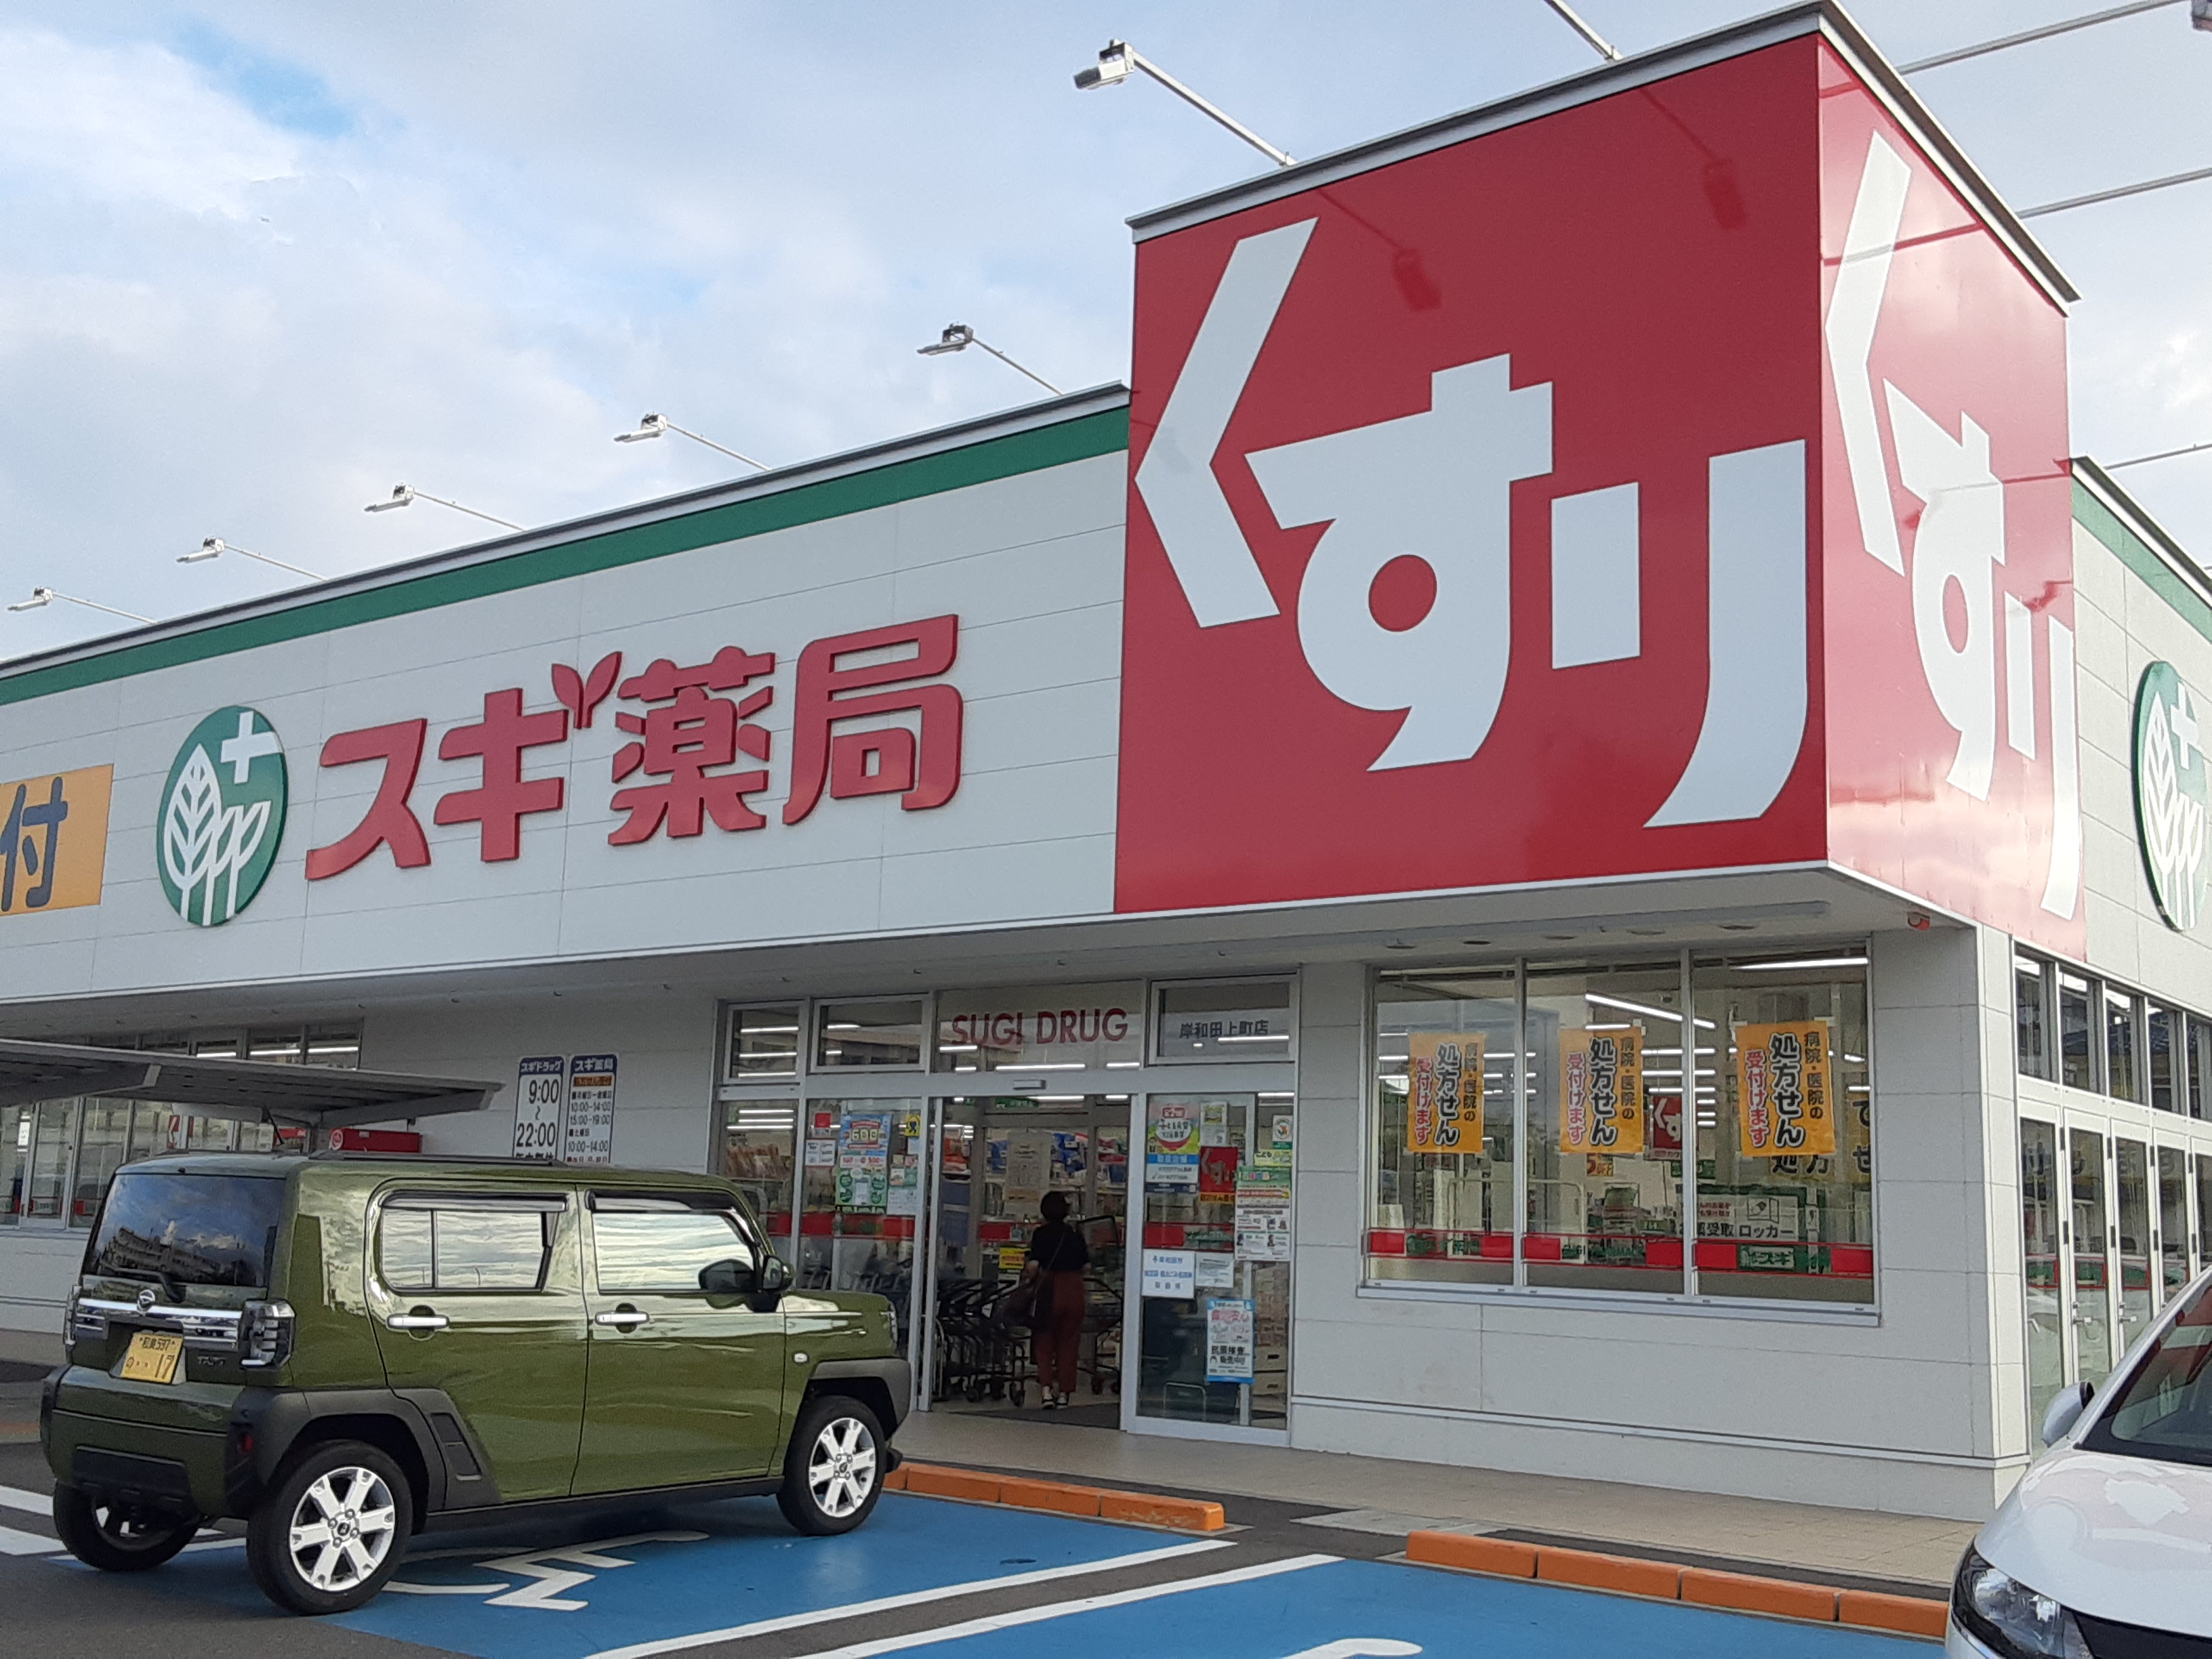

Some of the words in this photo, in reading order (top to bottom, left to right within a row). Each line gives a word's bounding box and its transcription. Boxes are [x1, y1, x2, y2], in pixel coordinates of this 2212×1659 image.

[1134, 216, 1808, 829] くすり
[1824, 129, 2081, 921] くすり
[305, 614, 964, 880] スギ薬局
[951, 1012, 1023, 1045] SUGI
[1036, 1008, 1128, 1044] DRUG
[1180, 1019, 1269, 1039] 岸和田上町店
[529, 1079, 559, 1104] 9:00
[1415, 1057, 1433, 1145] 受付けます
[1434, 1042, 1461, 1146] 処方せん
[1568, 1052, 1586, 1145] 受付けます
[1589, 1037, 1618, 1146] 処方せん
[1620, 1037, 1636, 1120] 病院・医院の
[1746, 1049, 1769, 1147] 受付けます
[1769, 1032, 1806, 1147] 処方せん
[1803, 1031, 1824, 1119] 病院・医院の
[516, 1122, 556, 1147] 22:00
[1739, 1225, 1795, 1238] ロッカー
